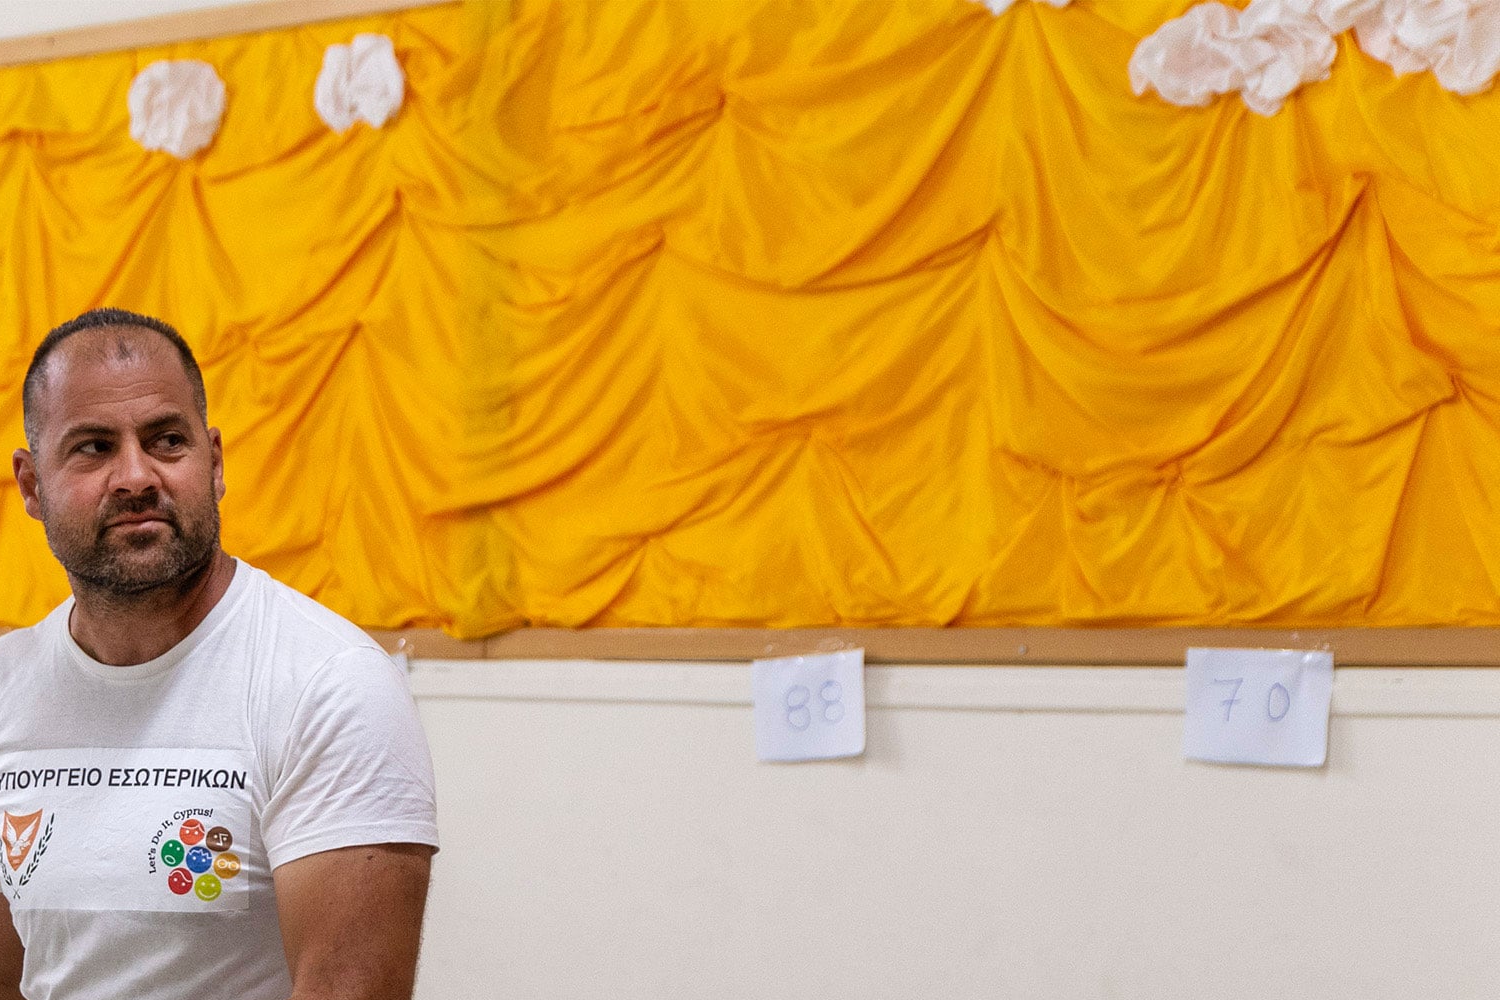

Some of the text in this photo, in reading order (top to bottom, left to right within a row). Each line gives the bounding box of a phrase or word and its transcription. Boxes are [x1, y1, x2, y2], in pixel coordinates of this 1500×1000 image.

[108, 768, 247, 790] ΕΣΩΤΕΡΙΚΩΝ
[173, 808, 214, 820] Cyprus!
[152, 830, 163, 845] Do
[148, 848, 157, 874] Let's
